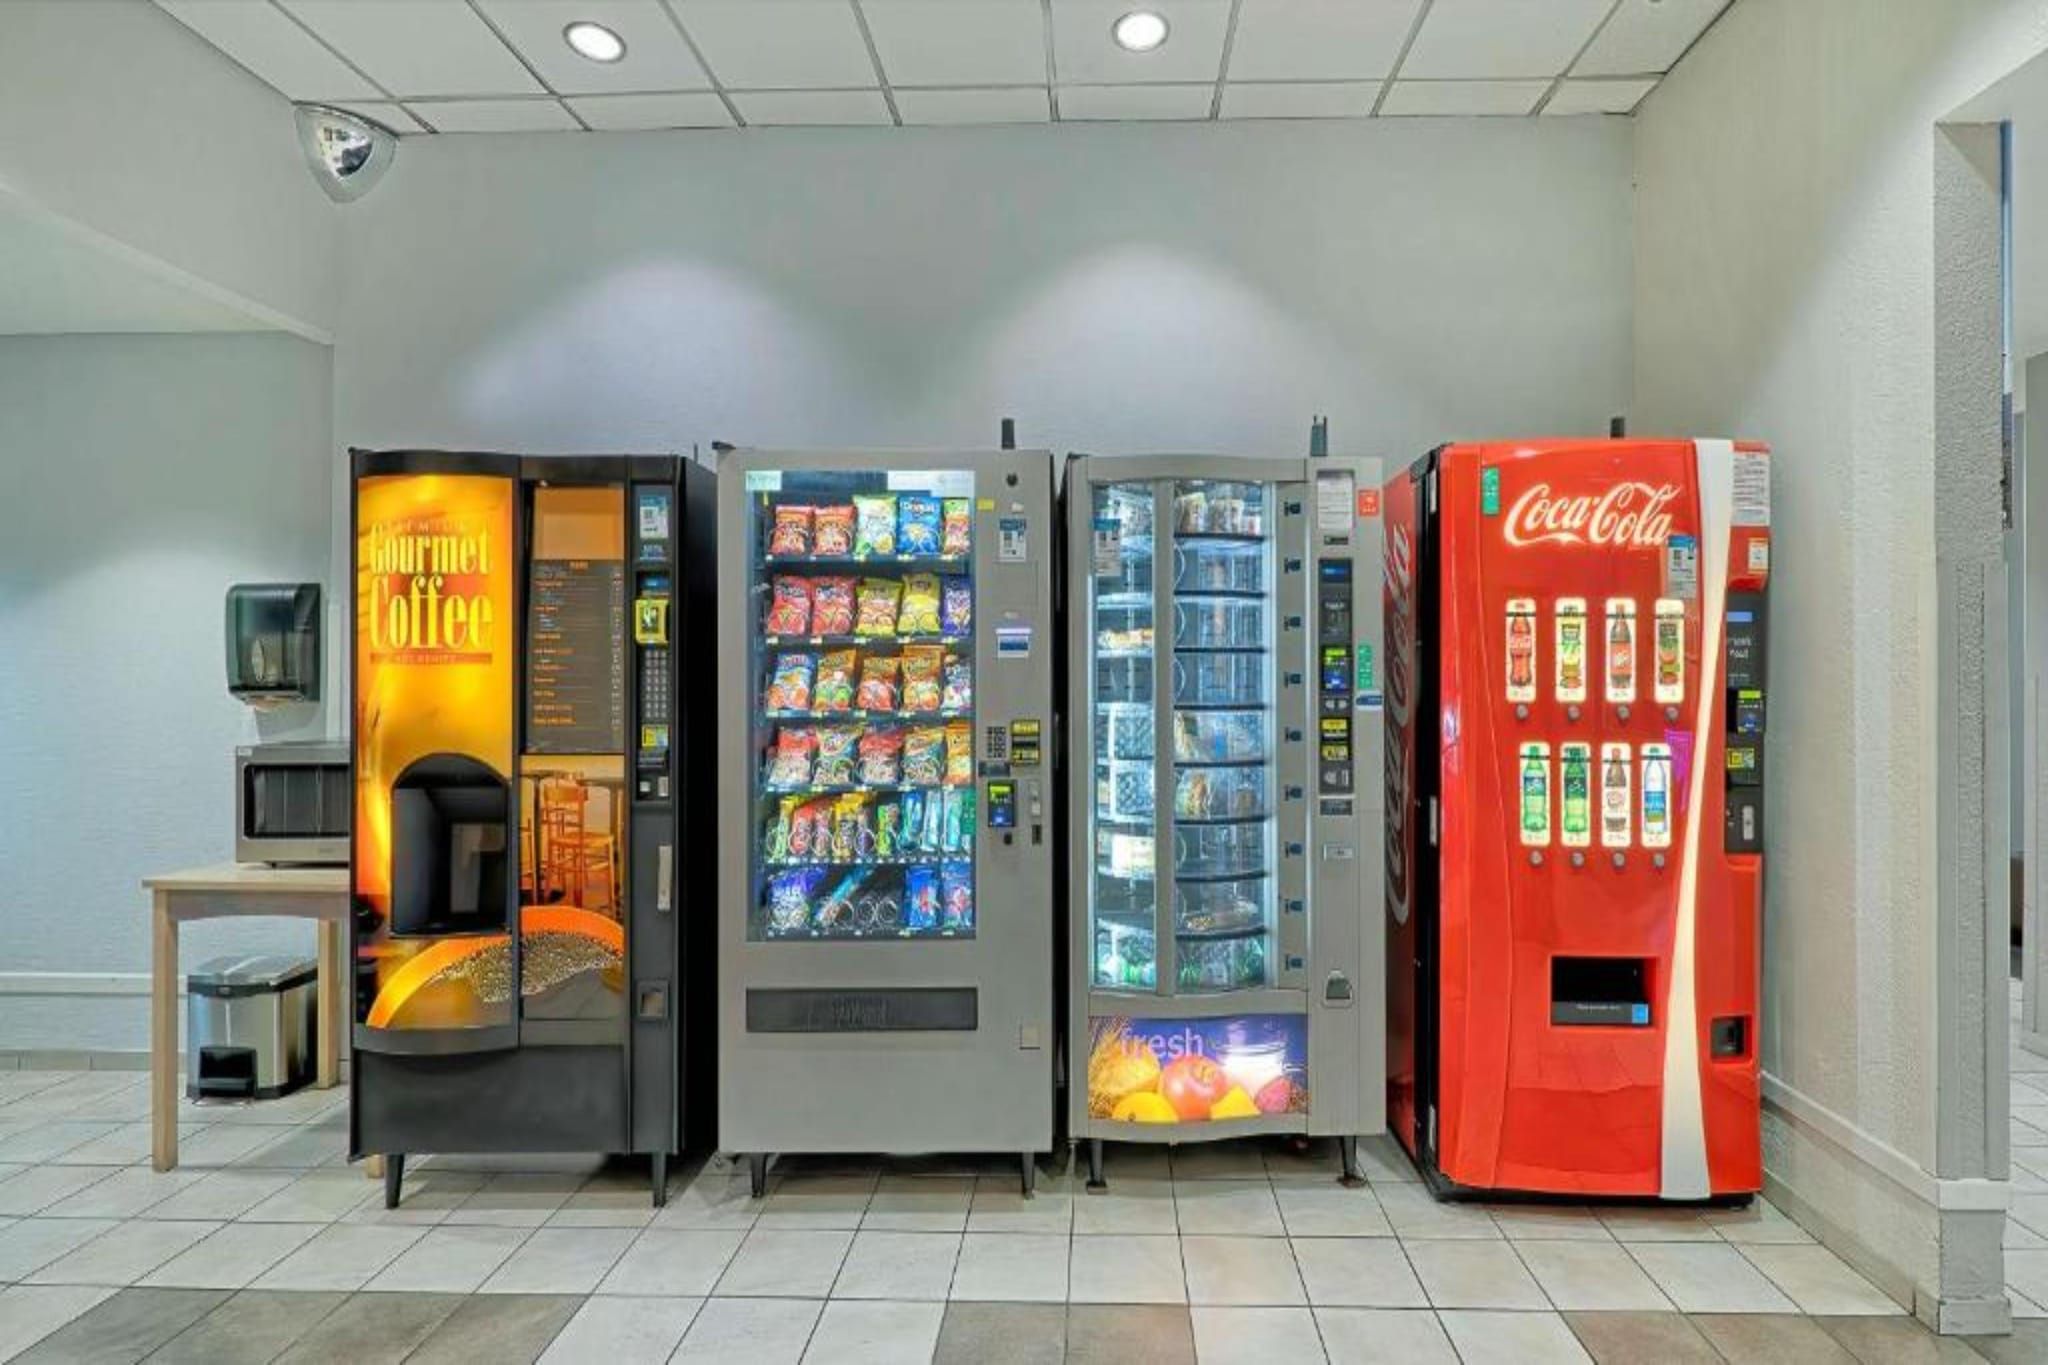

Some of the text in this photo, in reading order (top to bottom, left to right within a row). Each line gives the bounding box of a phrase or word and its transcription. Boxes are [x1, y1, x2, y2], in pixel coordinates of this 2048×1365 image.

[1503, 482, 1682, 547] Coca-Cola
[370, 523, 491, 574] Gourmet
[371, 576, 492, 649] Coffee
[1119, 1027, 1204, 1057] fresh
